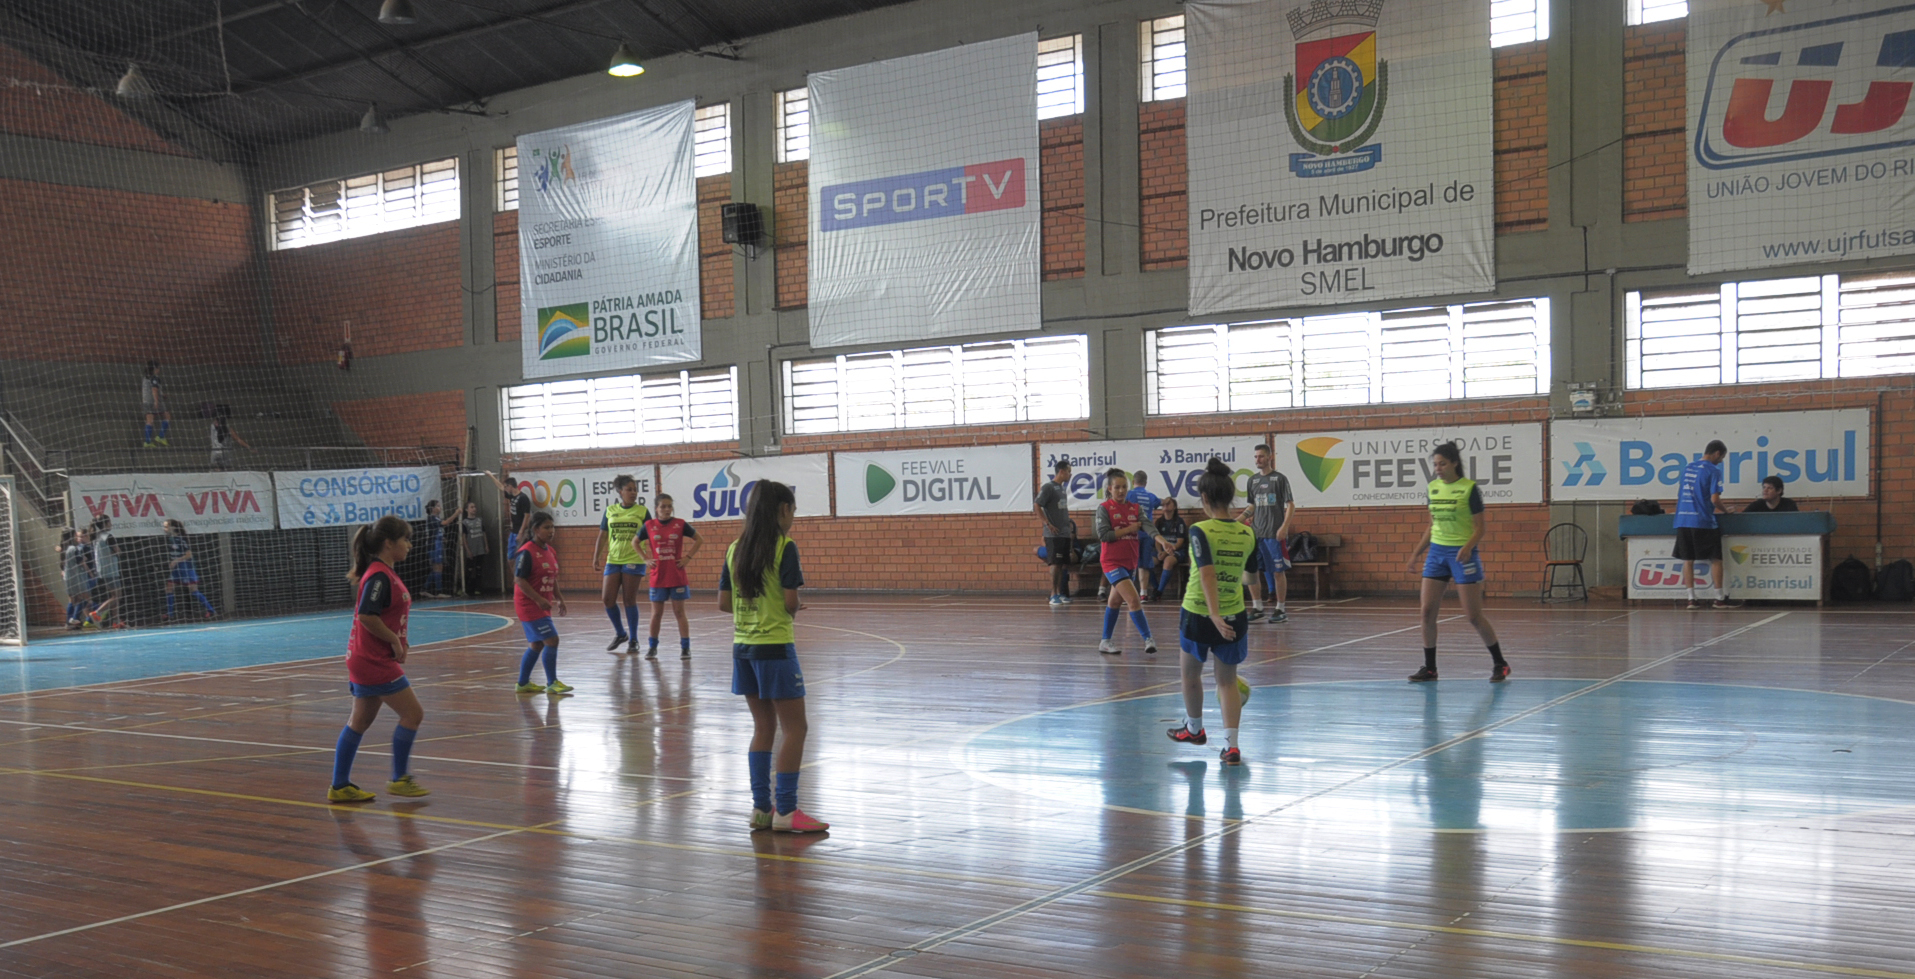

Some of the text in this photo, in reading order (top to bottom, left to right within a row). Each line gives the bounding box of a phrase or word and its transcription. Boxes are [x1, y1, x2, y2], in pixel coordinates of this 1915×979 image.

[1324, 156, 1371, 168] HAMBURGO
[1706, 175, 1770, 199] UNIÃO
[1776, 166, 1848, 191] JOVEM
[1855, 161, 1887, 181] DO
[834, 170, 1012, 220] SPORTV
[1200, 180, 1475, 230] Prefeitura Municipal de
[533, 218, 583, 236] SECRETARIA
[534, 234, 572, 250] ESPORTE
[1228, 232, 1444, 273] Novo Hamburgo
[1762, 228, 1915, 258] www.ujrfutsa
[535, 251, 596, 270] MINISTÉRIO DA
[535, 269, 583, 286] CIDADANIA
[1300, 267, 1376, 296] SMEL
[593, 289, 683, 315] PÁTRIA AMADA
[593, 308, 684, 343] BRASIL
[594, 338, 685, 355] GOVERNO FEDERAL
[1352, 436, 1512, 456] UNIVERSDADE
[901, 459, 965, 476] FEEVALE
[1353, 454, 1513, 489] FEEVLE
[300, 471, 421, 498] CONSÓRCIO
[592, 479, 650, 495] ESPTE
[902, 476, 1001, 502] DIGITAL
[82, 490, 261, 518] VIVA VIVA
[593, 498, 601, 512] E
[1352, 492, 1416, 501] CONHECIMENTO
[303, 497, 422, 525] é Banrisul
[1751, 553, 1813, 565] FEEVALE
[1746, 575, 1813, 589] Banrisul
